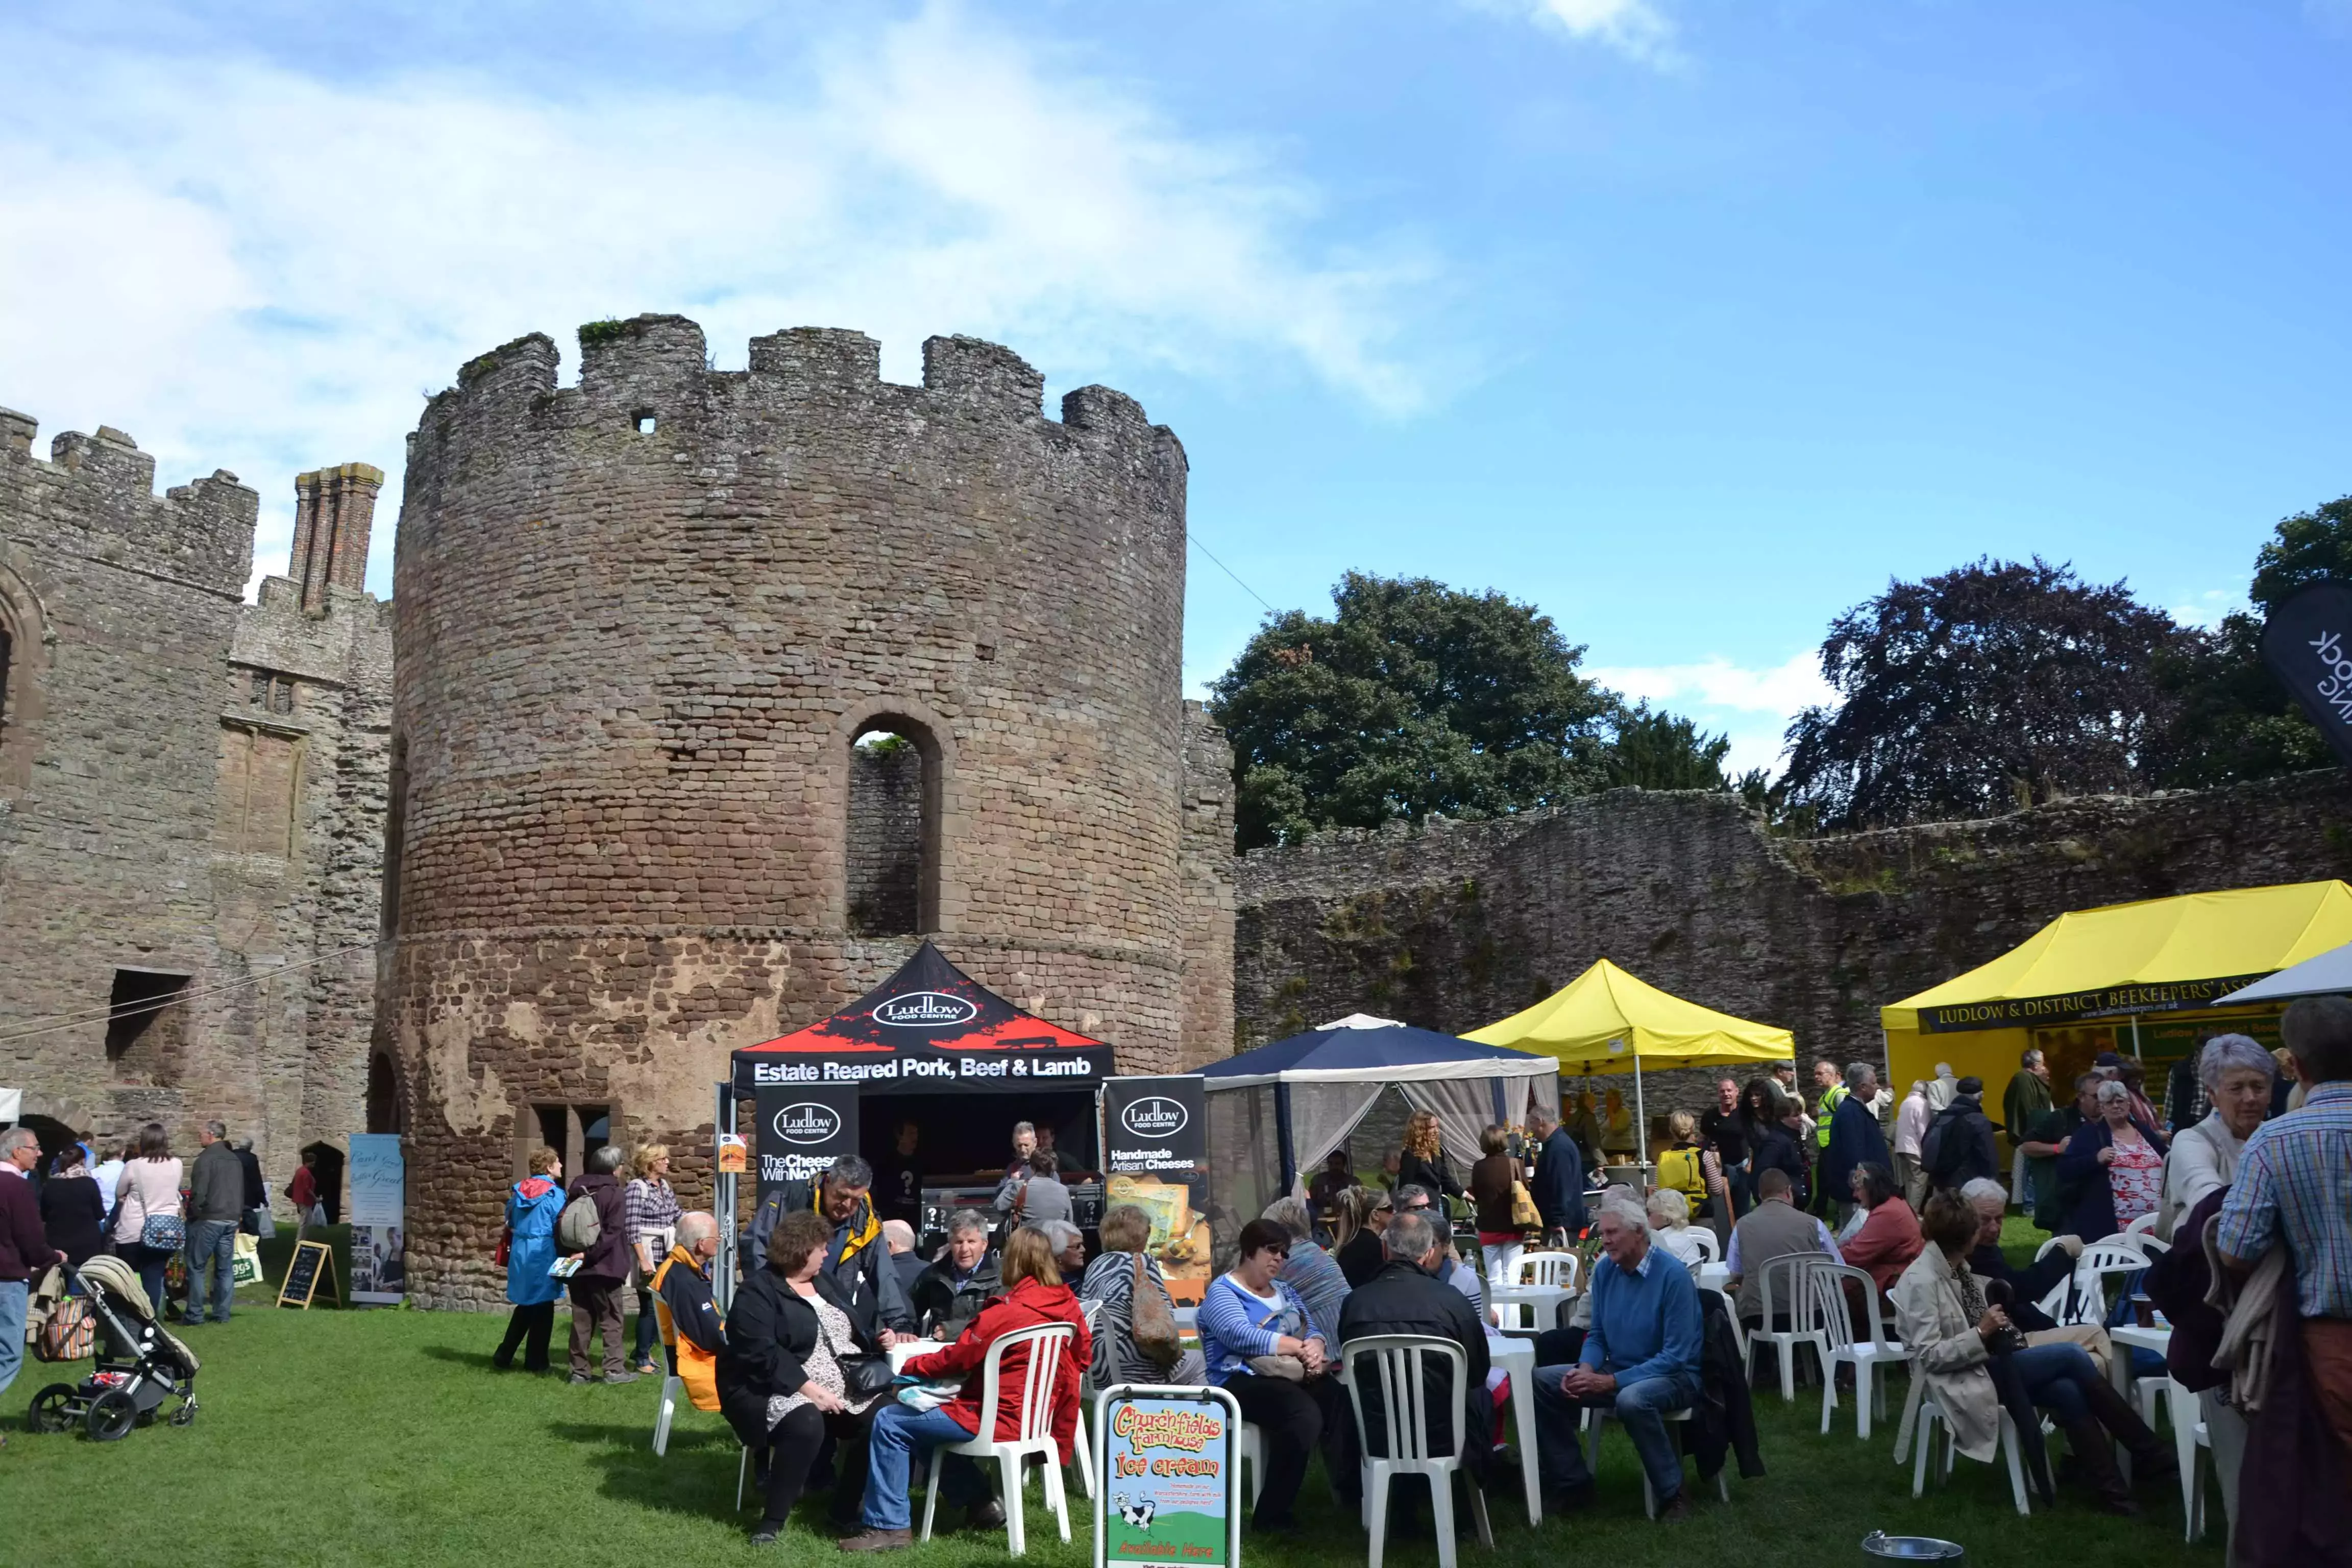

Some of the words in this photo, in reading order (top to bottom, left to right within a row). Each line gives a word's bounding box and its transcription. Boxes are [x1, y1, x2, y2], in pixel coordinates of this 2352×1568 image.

[886, 995, 964, 1016] Ludlow
[1940, 1004, 2004, 1024] LUDLOW
[2009, 1002, 2021, 1017] &
[2025, 993, 2102, 1016] DISTRICT
[754, 1063, 820, 1081] Estate
[823, 1059, 898, 1080] Reared
[902, 1058, 957, 1080] Pork,
[960, 1058, 1009, 1077] Beef
[1012, 1059, 1028, 1076] &
[1032, 1056, 1092, 1076] Lamb
[781, 1107, 832, 1129] Ludlow
[1129, 1101, 1180, 1122] Ludlow
[1111, 1148, 1172, 1161] Handmade
[1111, 1160, 1144, 1171] Artisan
[1145, 1159, 1195, 1170] Cheeses
[232, 1262, 251, 1276] ggs
[1115, 1404, 1221, 1438] Churchfields
[1133, 1427, 1205, 1453] farmhouse
[1153, 1457, 1220, 1477] cream
[1118, 1540, 1177, 1556] Available
[1182, 1542, 1214, 1558] Here
